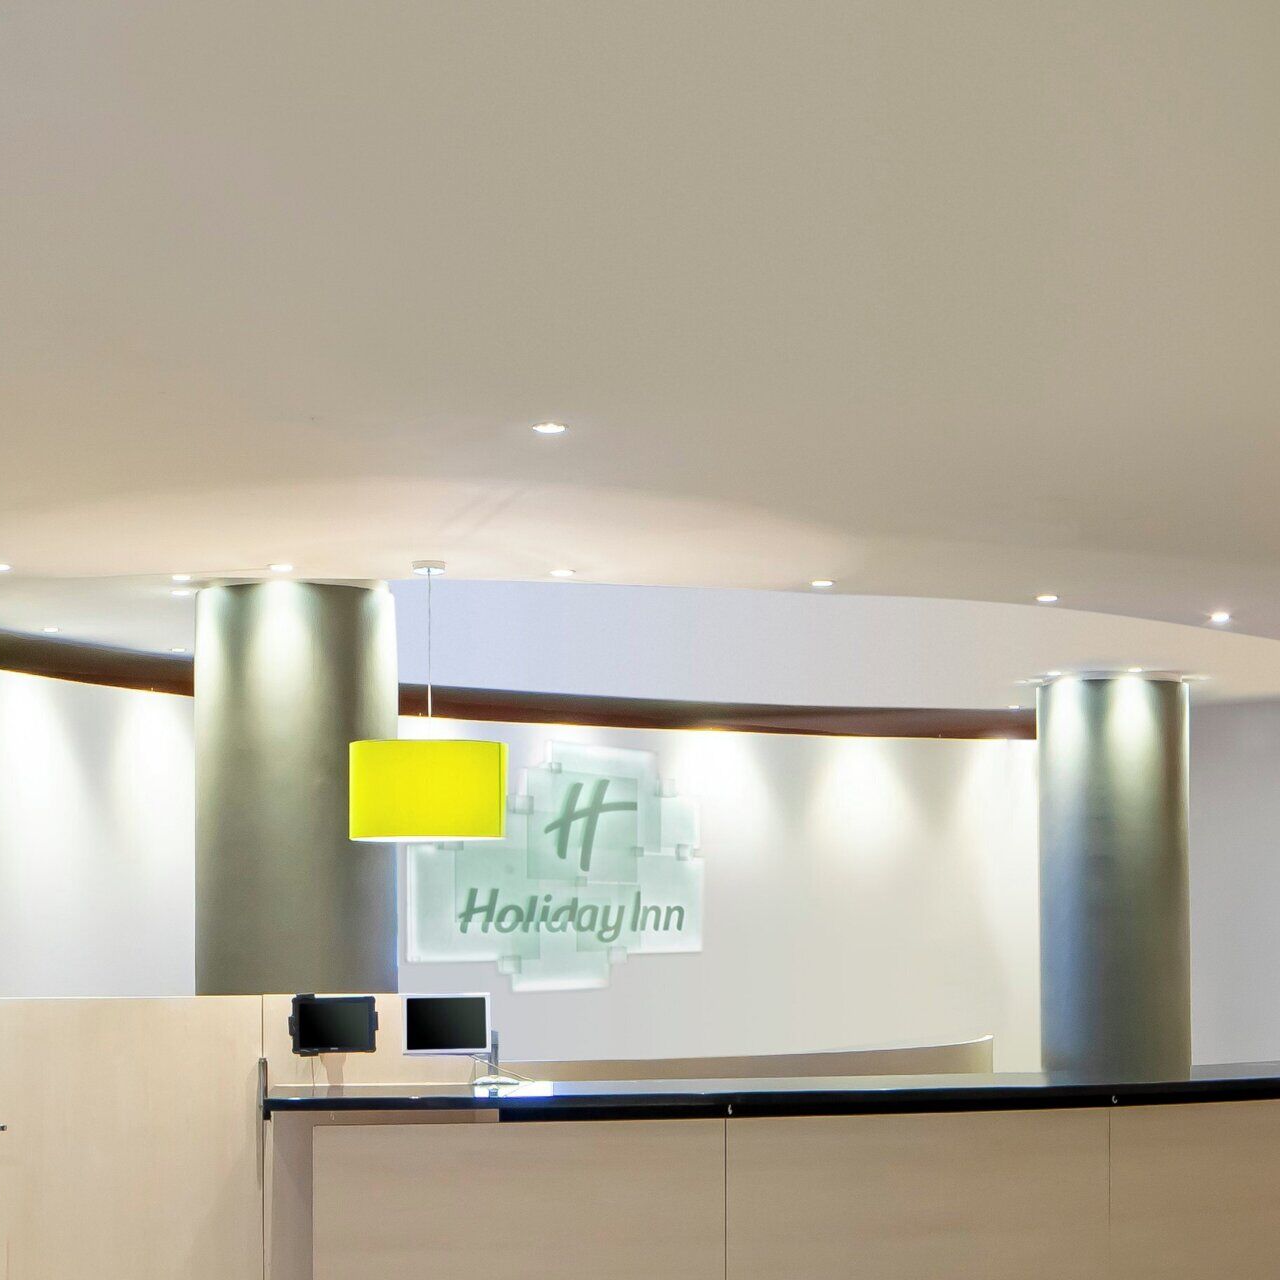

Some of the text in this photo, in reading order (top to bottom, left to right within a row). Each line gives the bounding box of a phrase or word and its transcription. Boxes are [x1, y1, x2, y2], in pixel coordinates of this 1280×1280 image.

[544, 779, 638, 872] H
[458, 888, 686, 943] Holiday Inn
